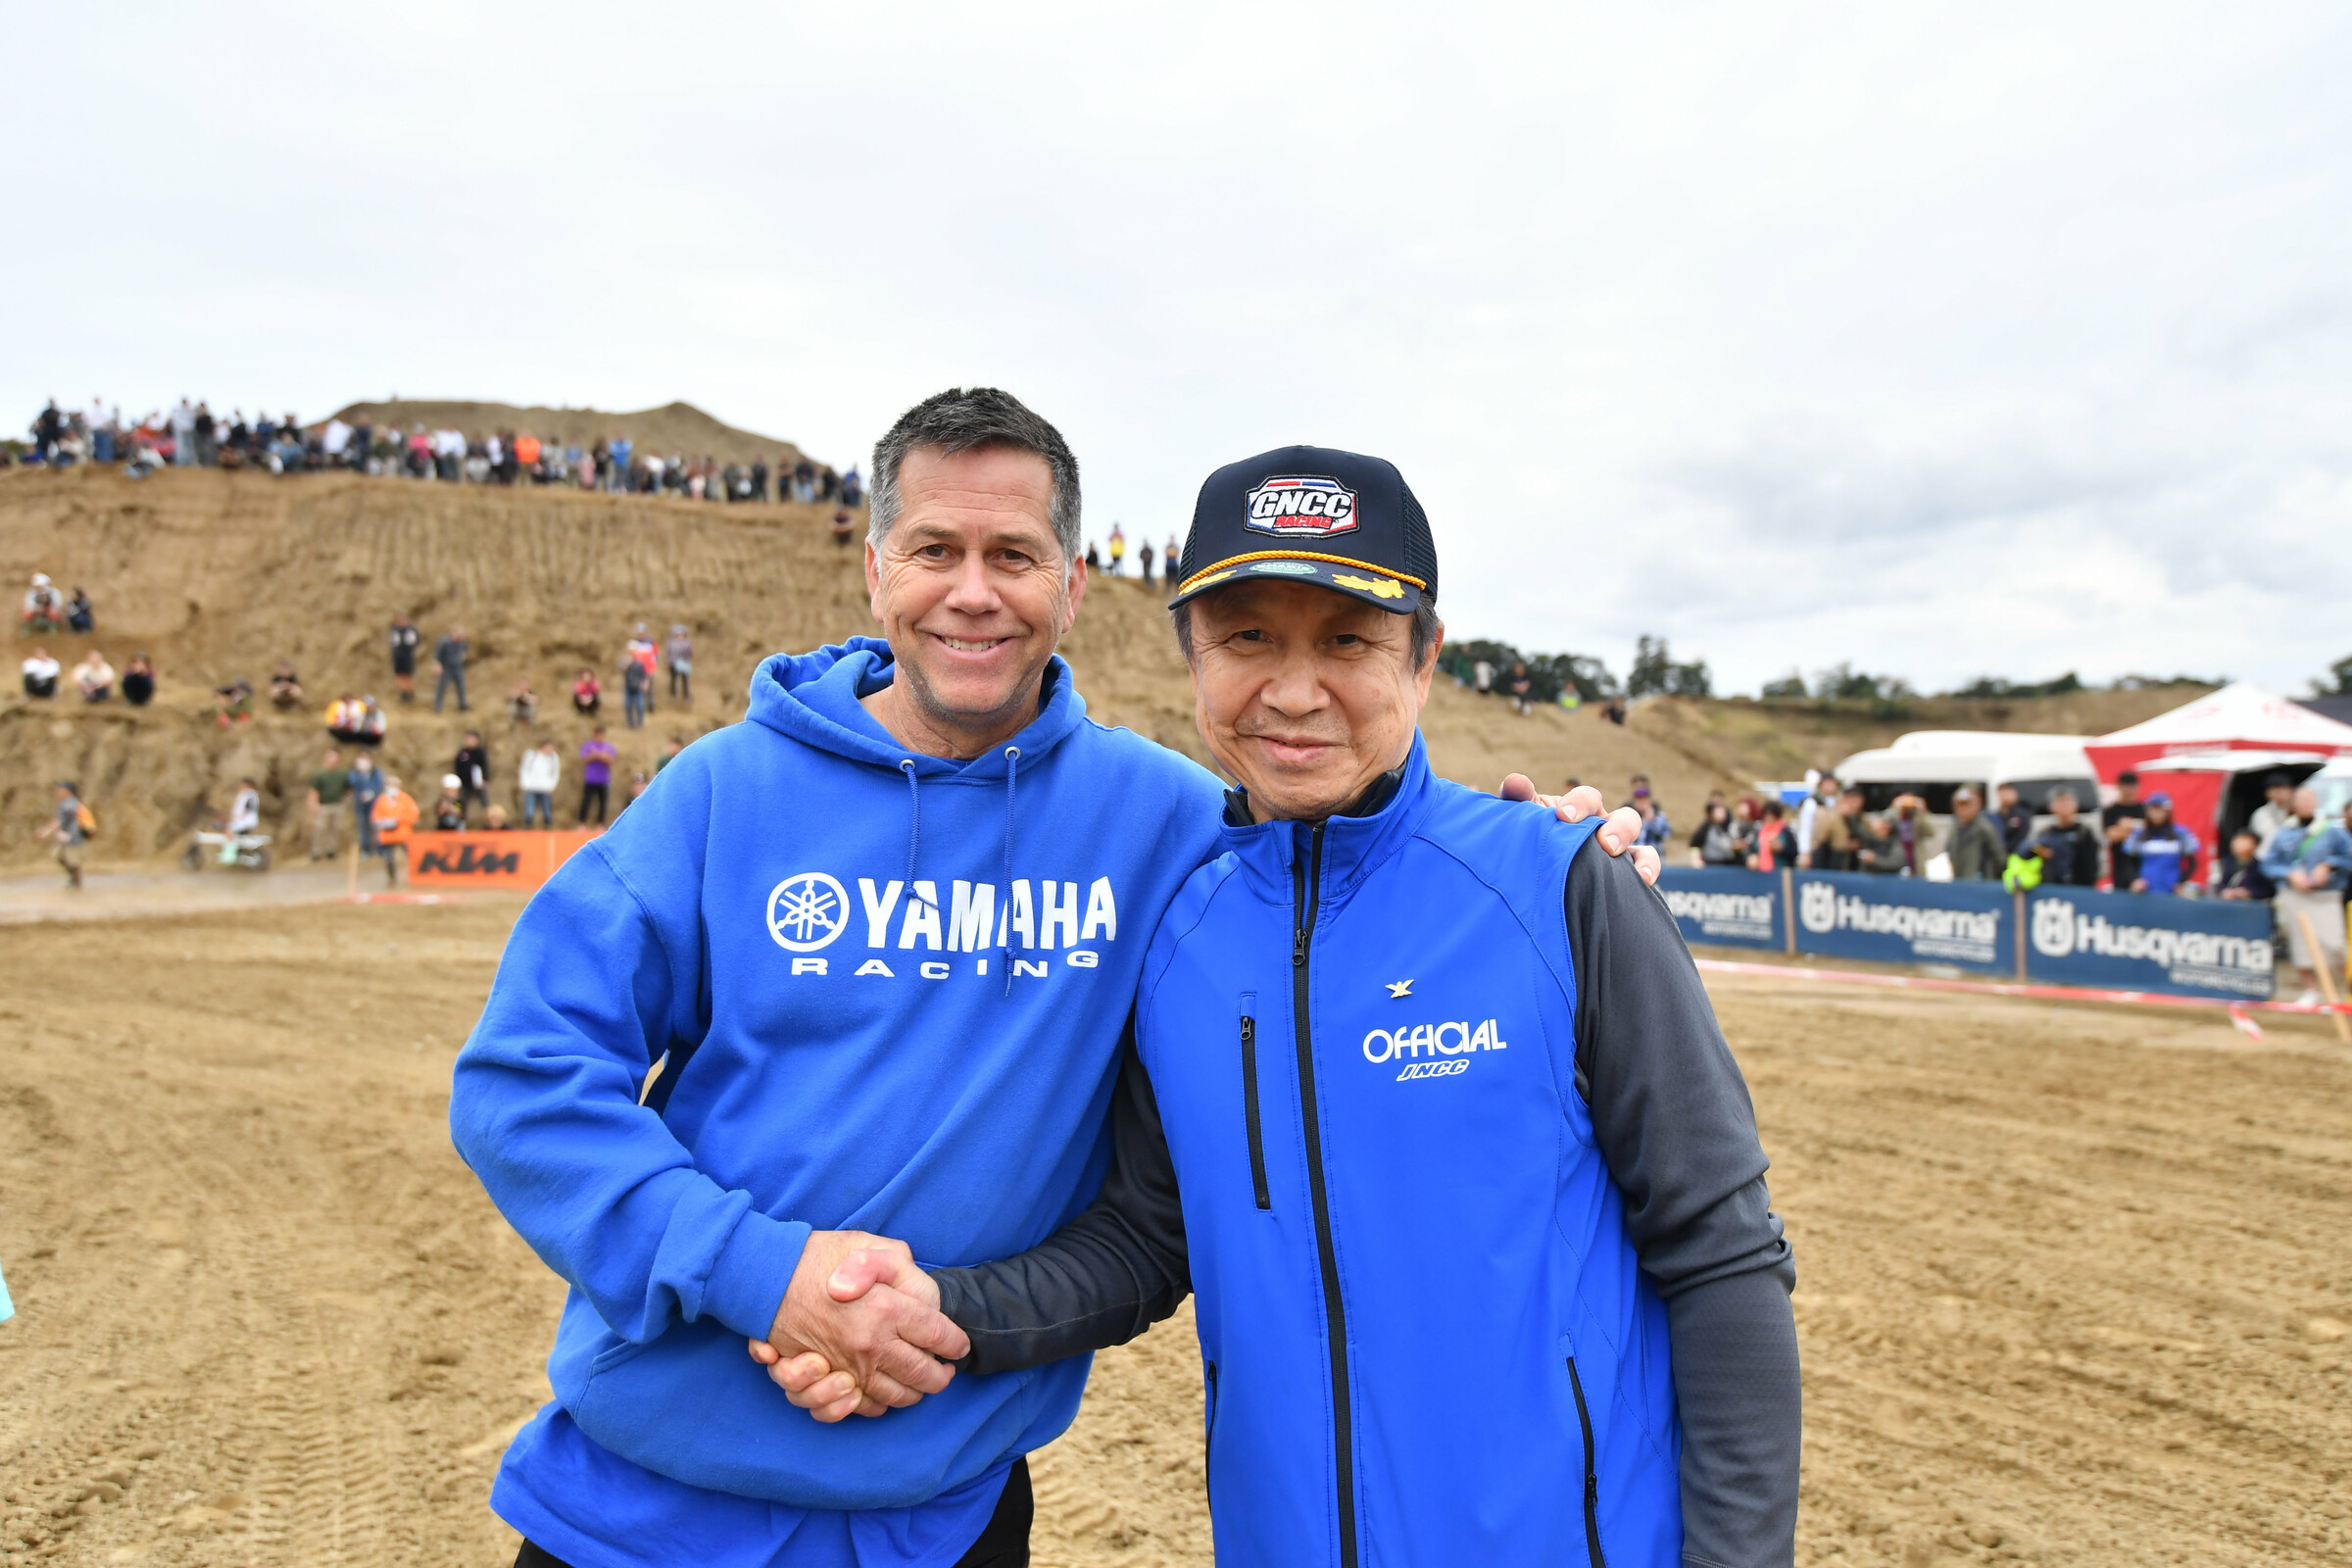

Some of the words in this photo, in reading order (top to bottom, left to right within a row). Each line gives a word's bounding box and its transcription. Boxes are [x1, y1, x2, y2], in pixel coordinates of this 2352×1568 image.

[1250, 490, 1352, 518] GNCC
[1273, 514, 1333, 528] RACING
[418, 845, 520, 874] KTM
[858, 875, 1117, 953] YAMAHA
[1836, 894, 1998, 945] Husqvarna
[2075, 913, 2275, 971] Husqvarna
[790, 950, 1100, 980] RACING
[1362, 1018, 1507, 1063] OFFICIAL
[1396, 1058, 1470, 1082] JNCC
